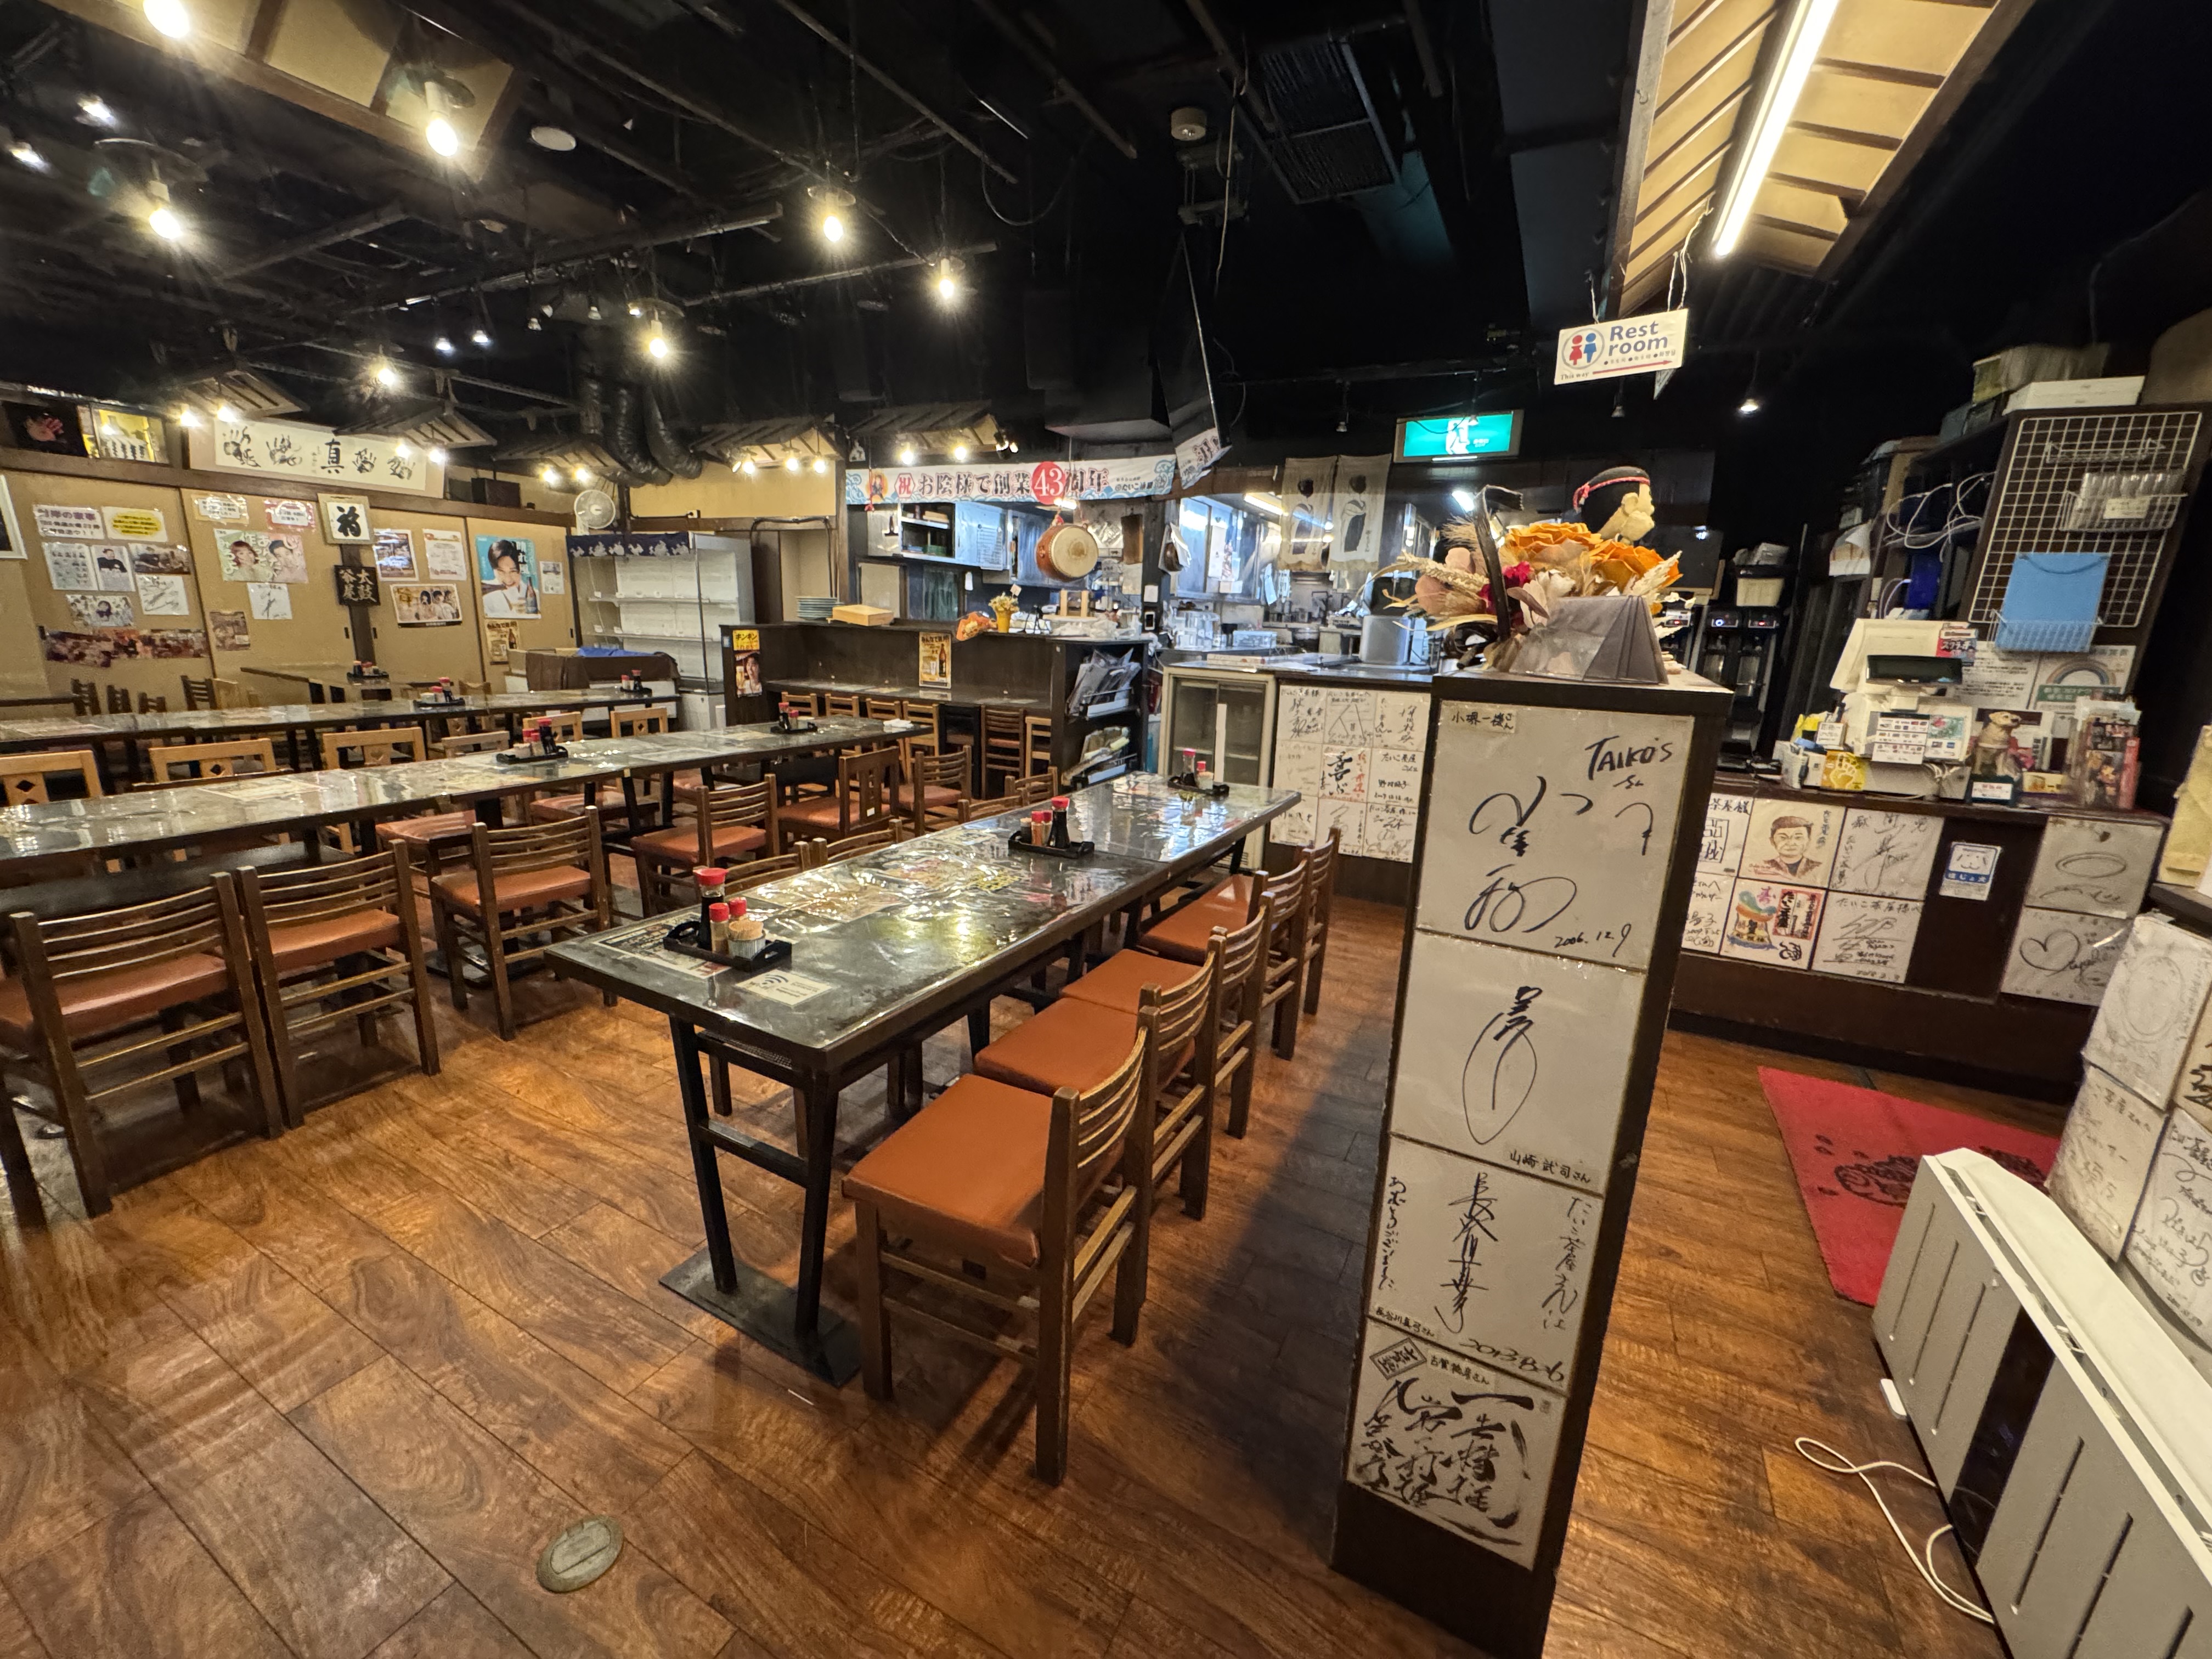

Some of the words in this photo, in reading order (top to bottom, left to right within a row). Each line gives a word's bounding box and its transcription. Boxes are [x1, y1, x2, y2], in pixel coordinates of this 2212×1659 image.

[1610, 320, 1659, 341] Rest
[1609, 336, 1668, 356] room
[899, 476, 912, 495] 祝
